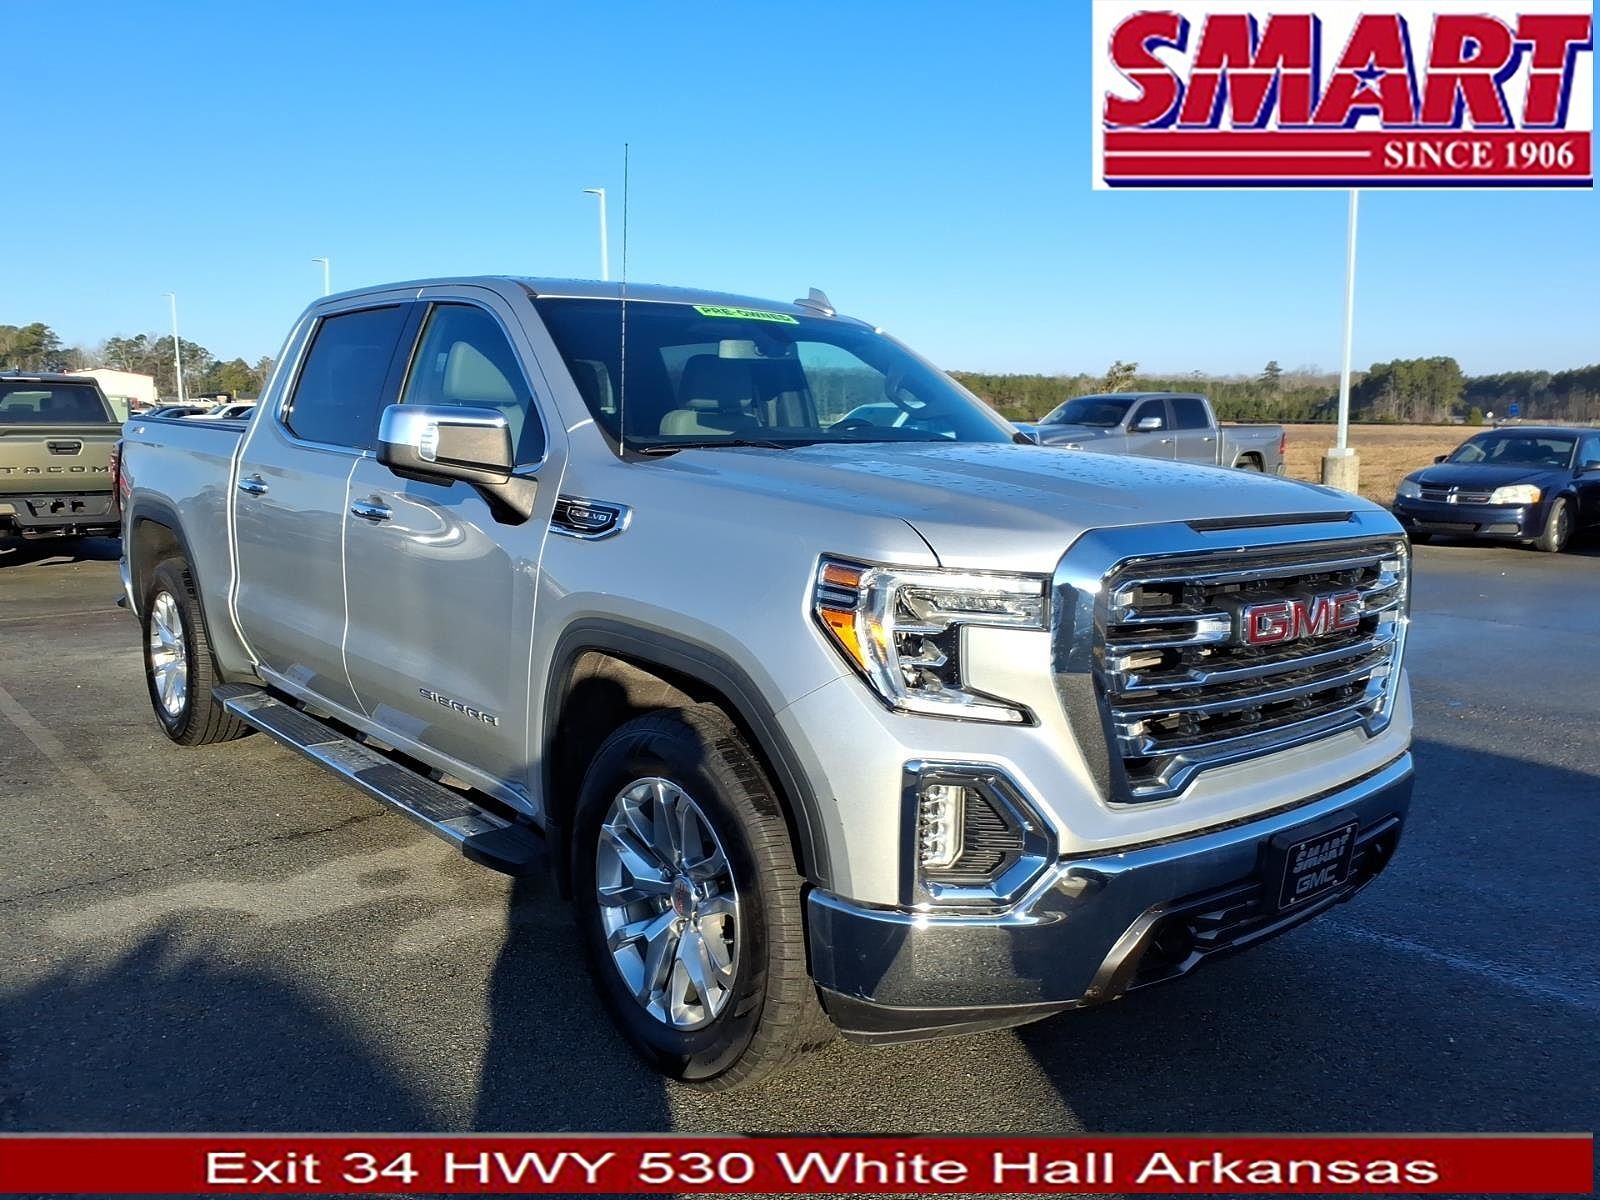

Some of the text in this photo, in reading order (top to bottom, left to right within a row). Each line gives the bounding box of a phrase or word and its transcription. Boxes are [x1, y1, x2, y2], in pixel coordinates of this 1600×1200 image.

[701, 306, 793, 322] PRE-OWNED
[0, 465, 111, 474] TACOM
[1241, 590, 1362, 646] GMC
[419, 687, 500, 727] SIERRA
[1296, 863, 1339, 894] GMC
